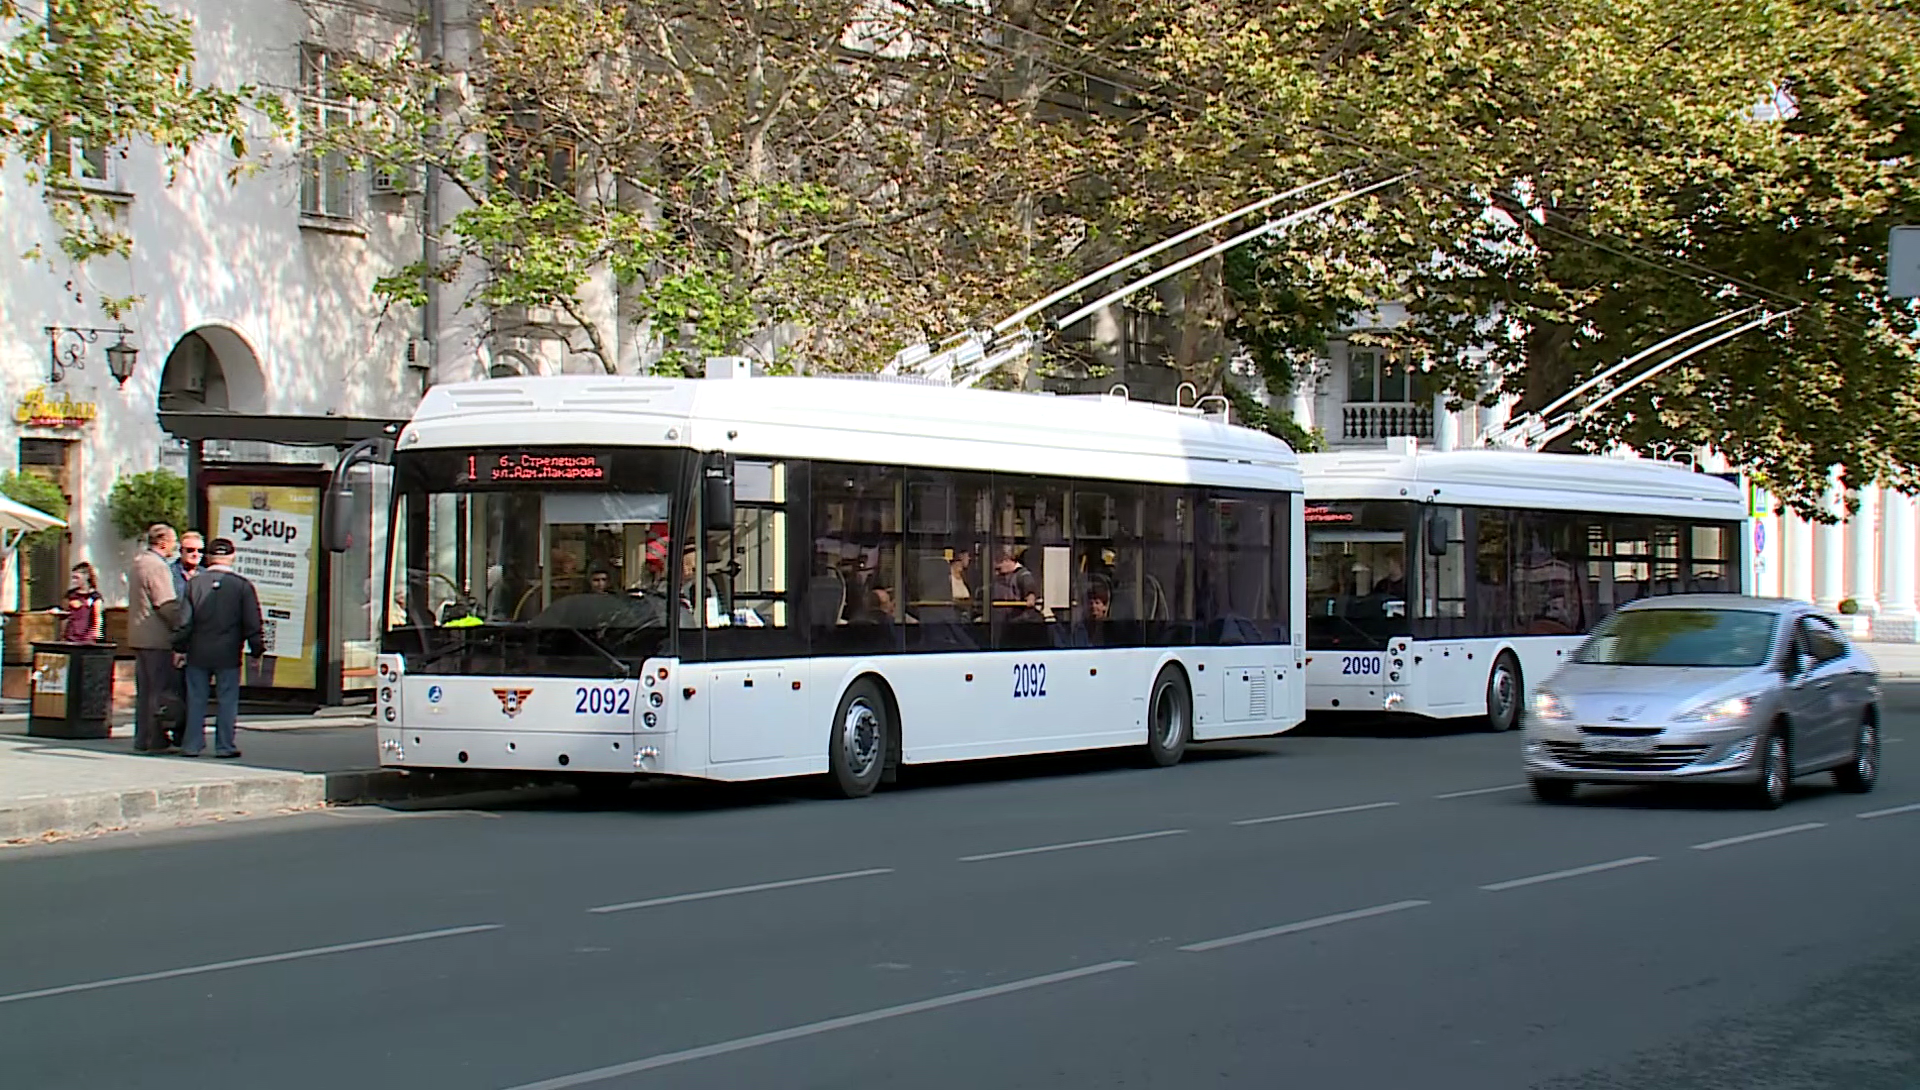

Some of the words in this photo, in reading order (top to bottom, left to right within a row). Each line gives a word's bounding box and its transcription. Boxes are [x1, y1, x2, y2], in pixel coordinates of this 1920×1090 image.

[467, 455, 477, 480] 1
[520, 454, 596, 468] Стрелецкая
[232, 515, 297, 544] PickUp
[1342, 656, 1381, 675] 2090
[1013, 663, 1047, 698] 2092
[575, 687, 631, 715] 2092
